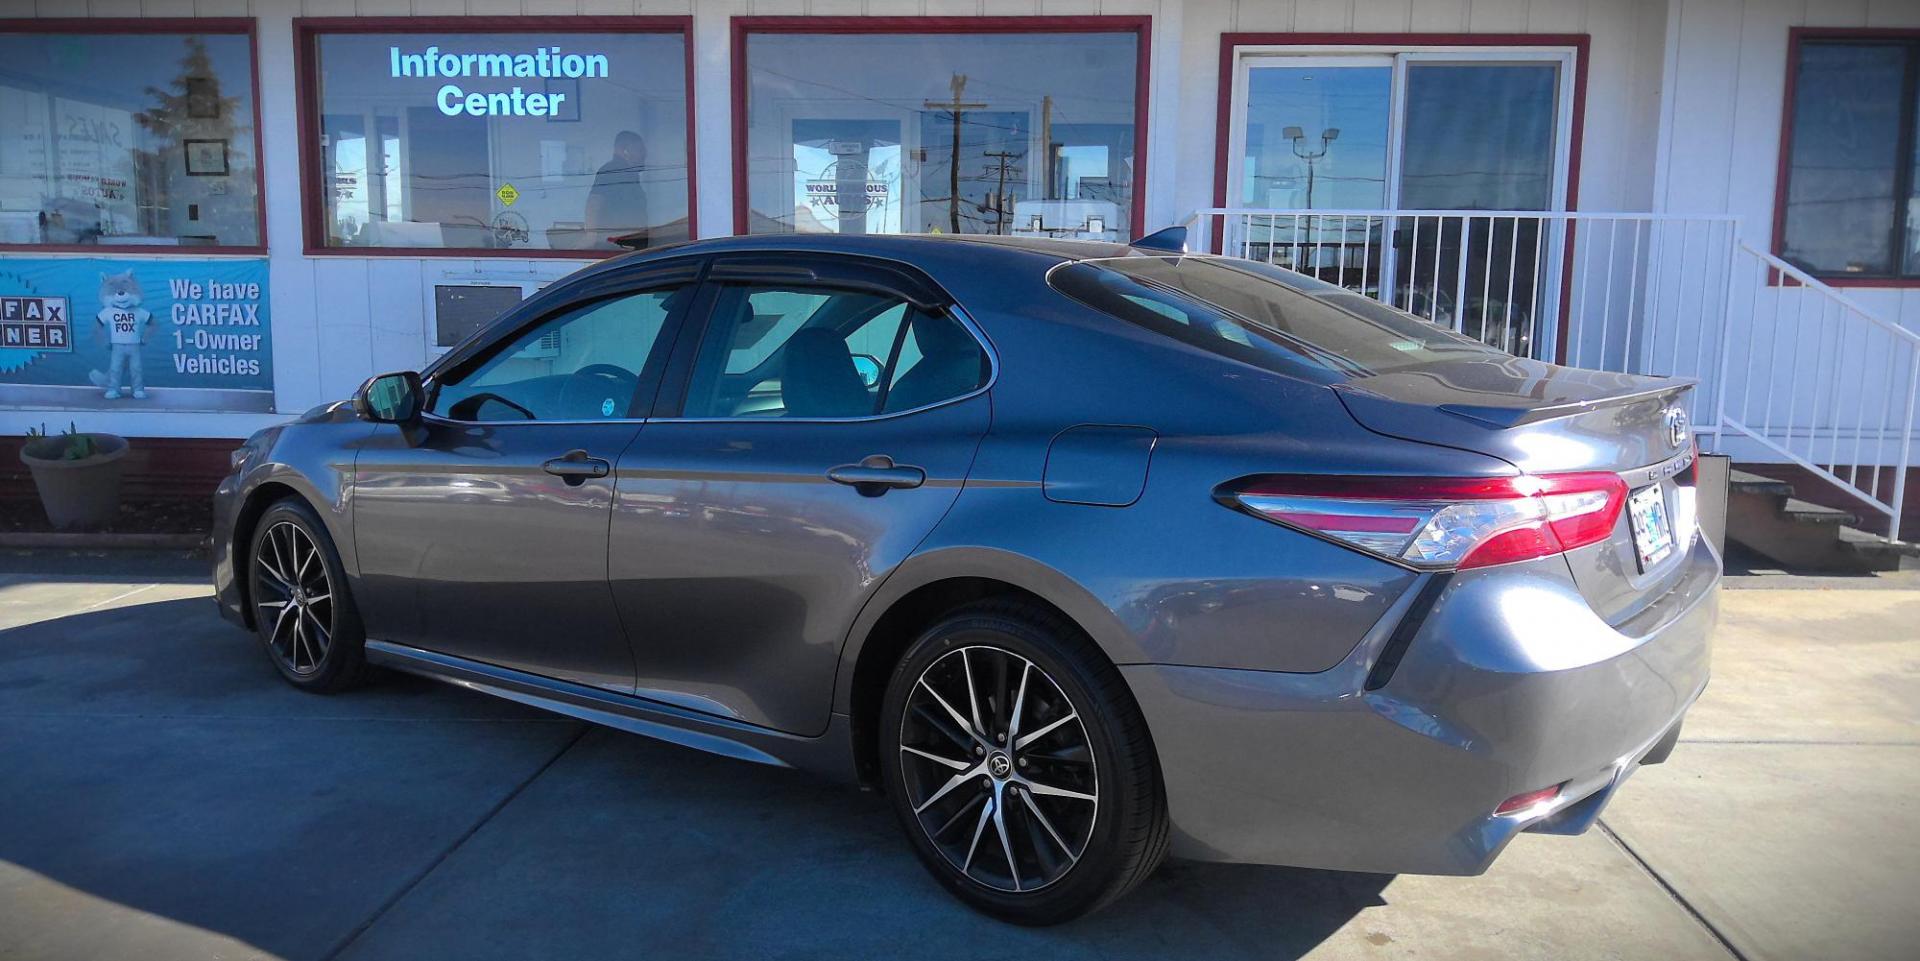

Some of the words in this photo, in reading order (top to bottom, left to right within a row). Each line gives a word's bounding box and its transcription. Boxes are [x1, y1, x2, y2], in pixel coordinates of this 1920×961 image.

[390, 46, 609, 78] Information
[437, 84, 565, 116] Center
[806, 184, 839, 193] WORL
[169, 279, 202, 300] We
[208, 279, 260, 300] have
[5, 301, 62, 321] FAX
[113, 313, 135, 323] CAR
[171, 303, 260, 326] CARFAX
[6, 327, 63, 344] NER
[115, 322, 135, 333] FOX
[172, 329, 261, 351] 1-Owner
[173, 353, 260, 376] Vehicles
